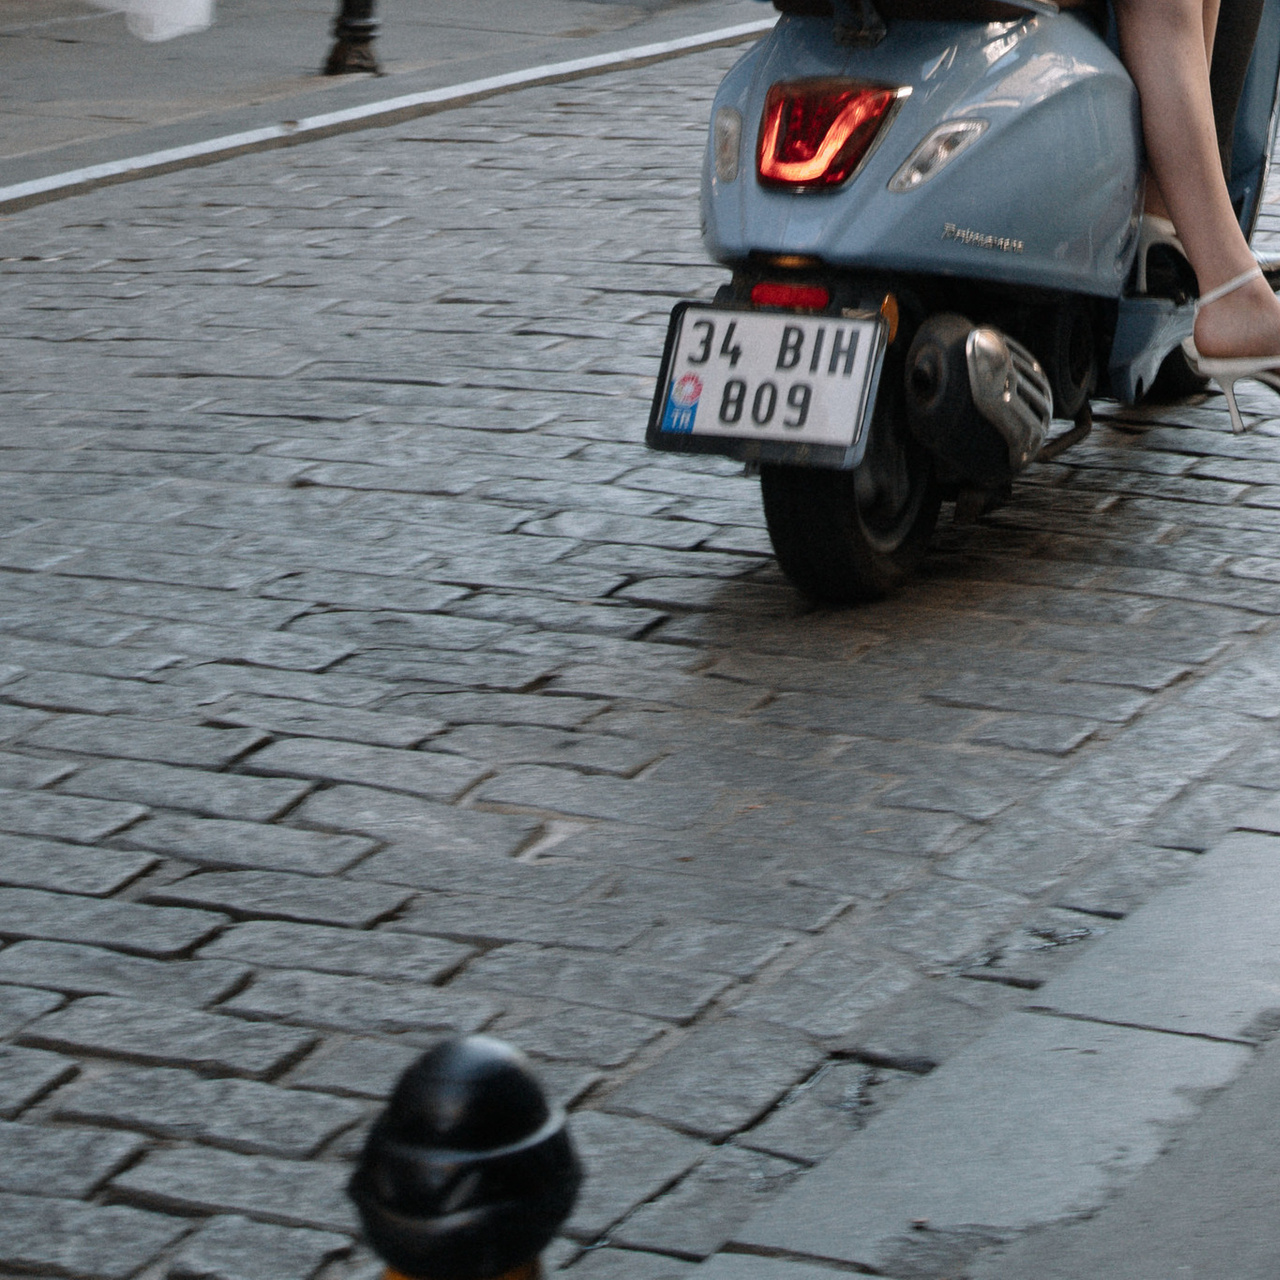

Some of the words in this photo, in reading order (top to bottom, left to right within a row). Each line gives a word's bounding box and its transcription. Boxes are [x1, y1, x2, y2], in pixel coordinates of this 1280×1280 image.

[687, 318, 742, 368] 34
[775, 324, 860, 376] BIH
[670, 409, 692, 430] TR
[718, 380, 812, 429] 809
